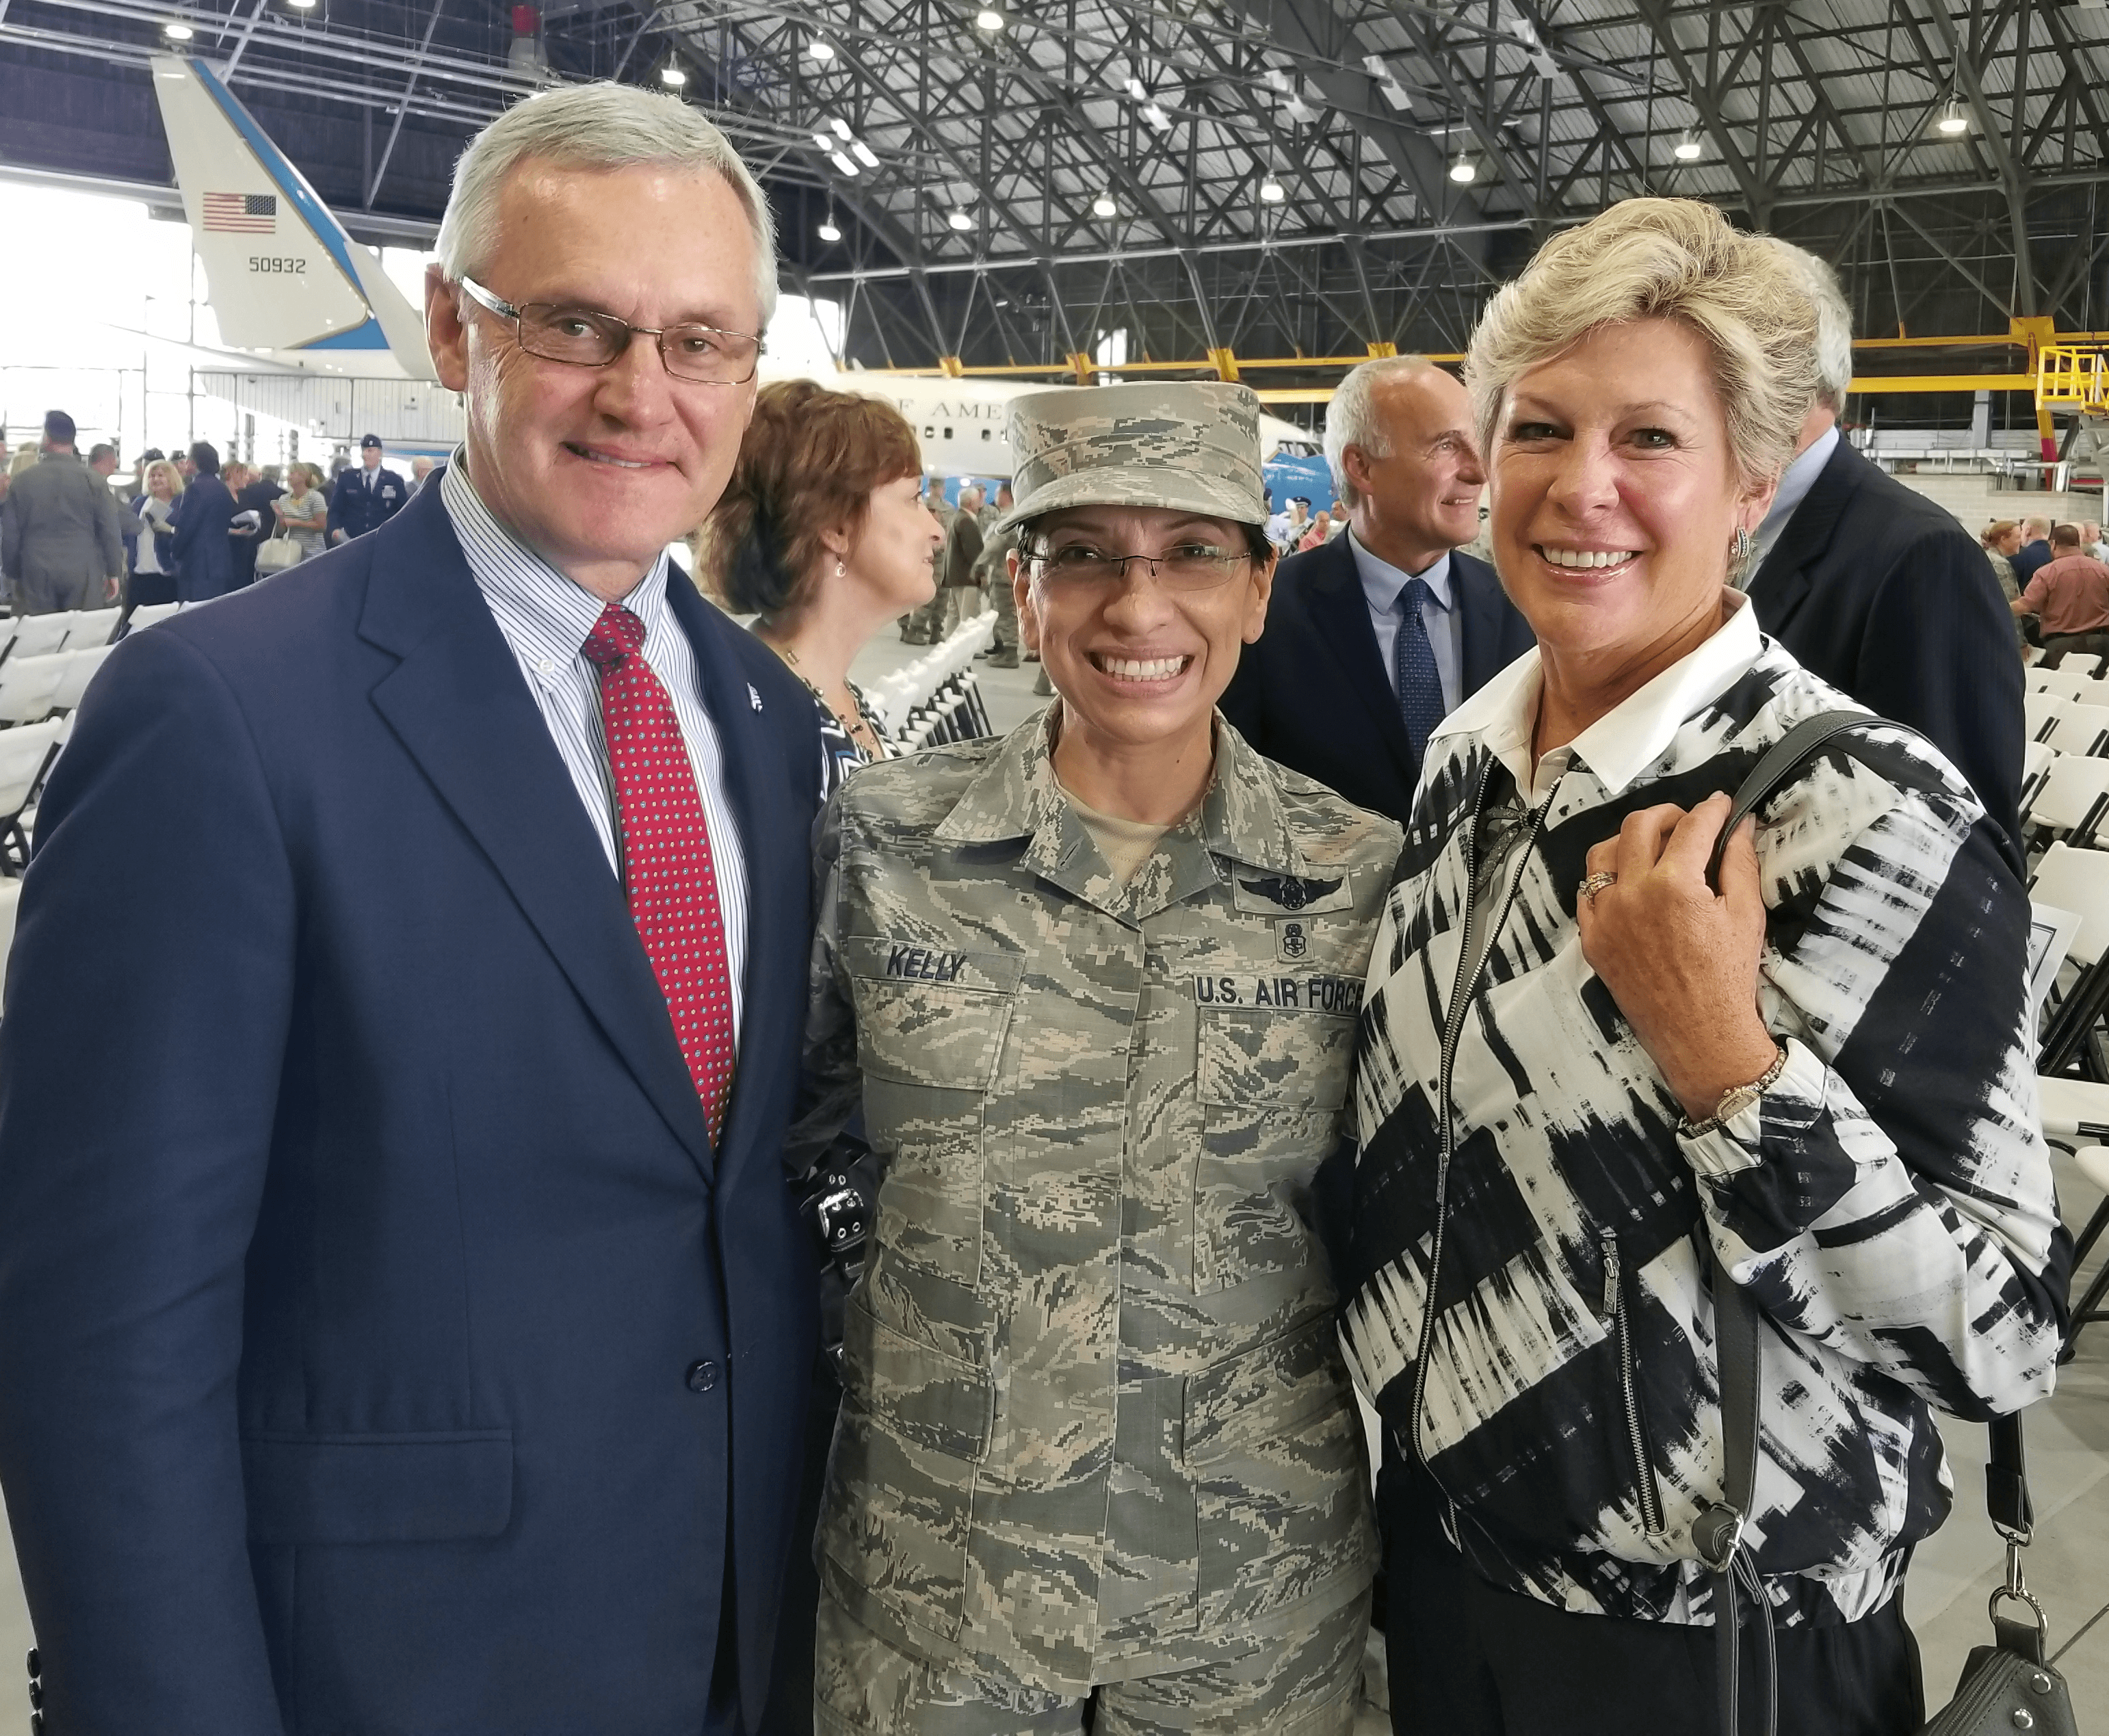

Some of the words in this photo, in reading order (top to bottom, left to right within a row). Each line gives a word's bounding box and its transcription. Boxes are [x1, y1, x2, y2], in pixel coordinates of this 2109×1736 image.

[249, 256, 306, 274] 50932
[887, 945, 967, 982] KELLY
[1197, 976, 1243, 1004] U.S.
[1255, 978, 1298, 1007] AIR
